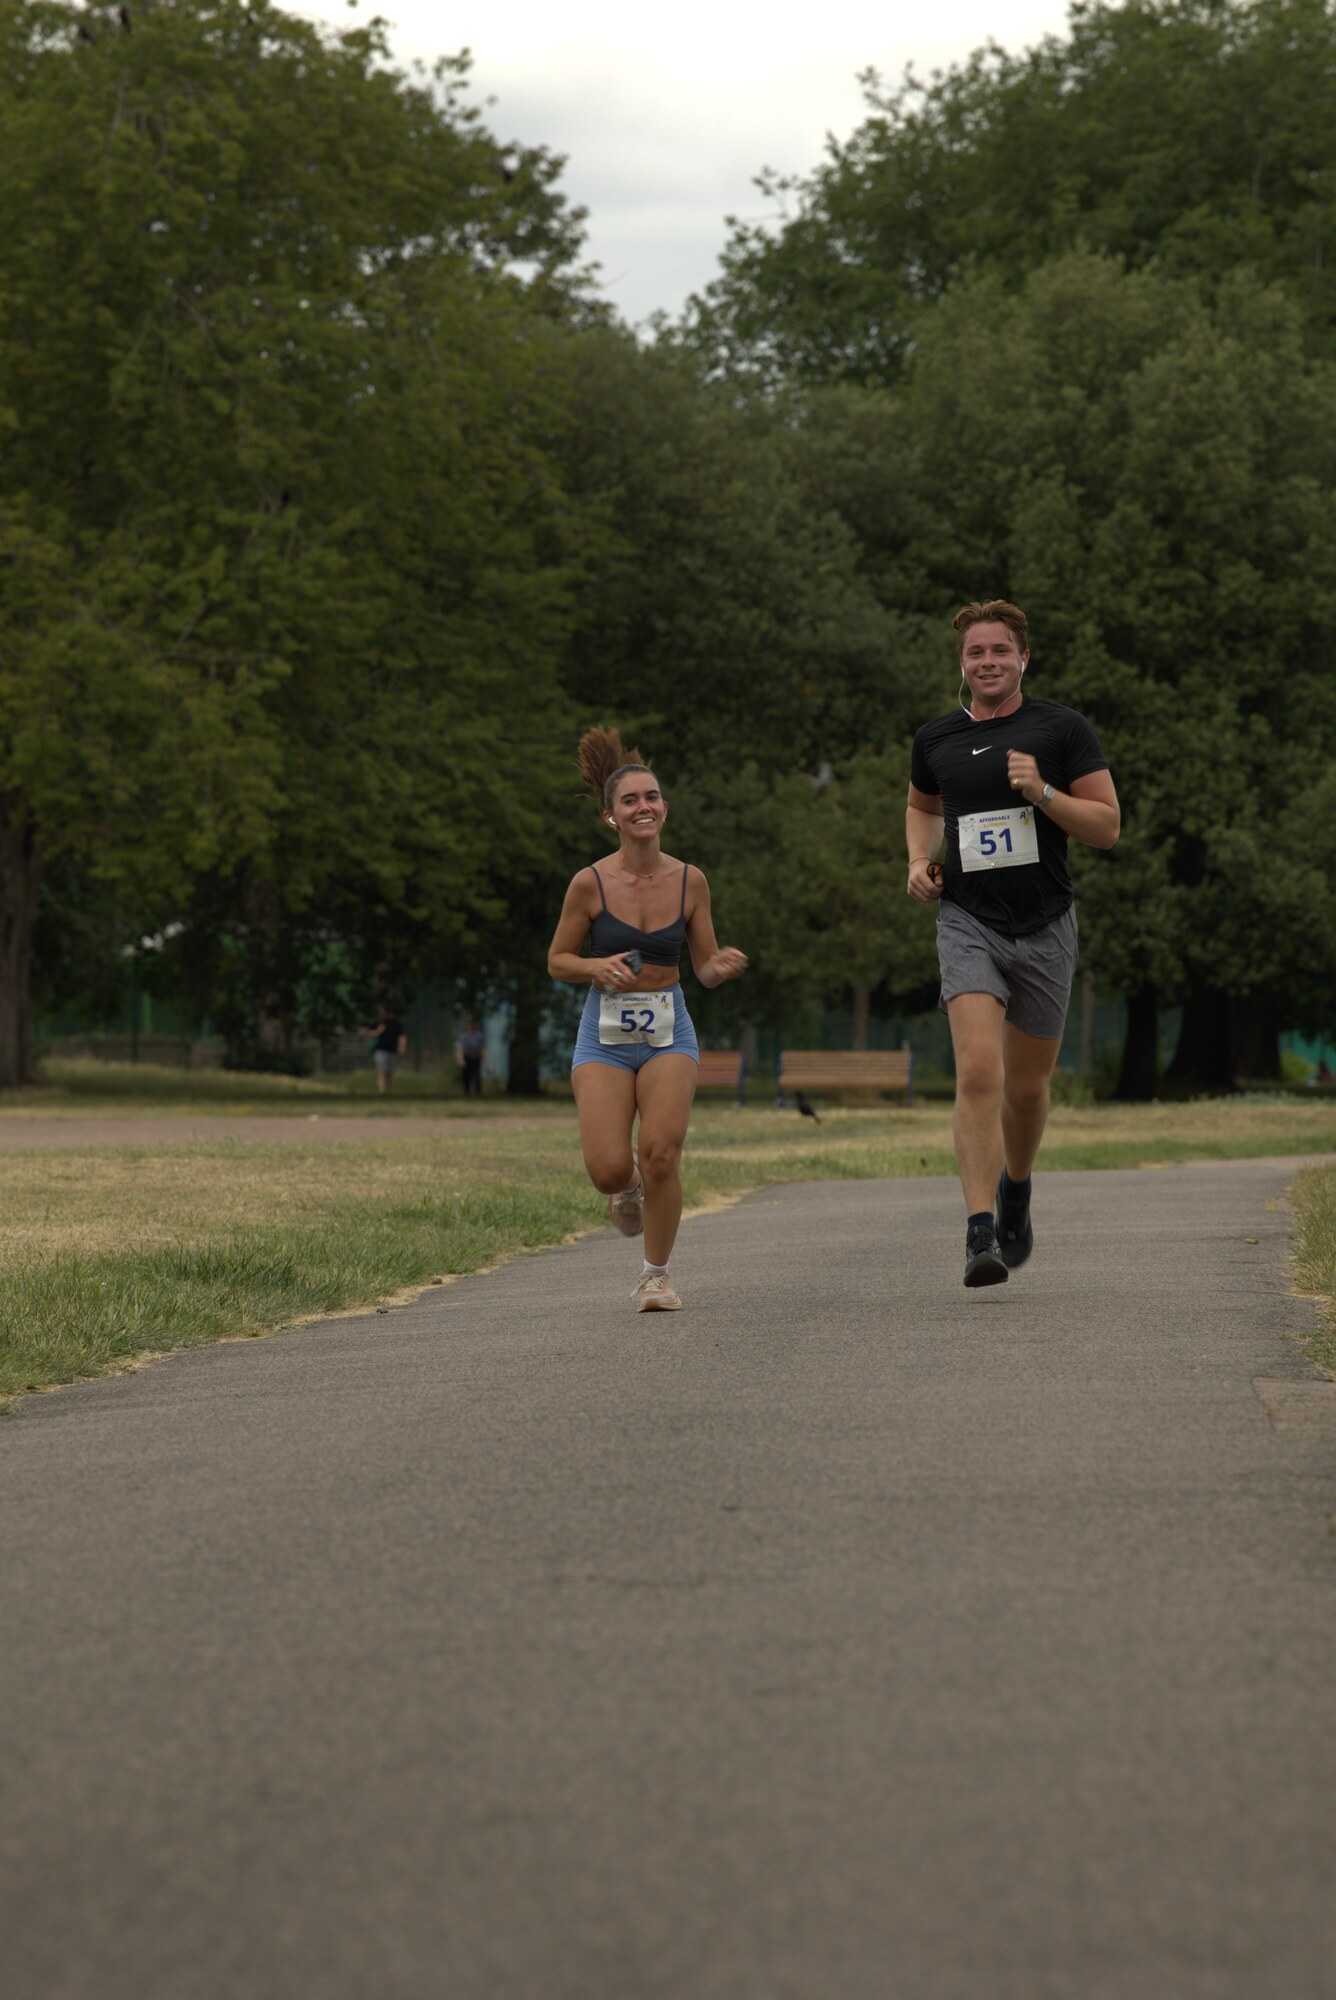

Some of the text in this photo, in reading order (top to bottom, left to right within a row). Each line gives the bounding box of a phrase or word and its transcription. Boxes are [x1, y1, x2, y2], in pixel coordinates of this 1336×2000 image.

[979, 815, 1010, 823] AFFORDABLE
[980, 828, 1013, 856] 51
[620, 1009, 655, 1034] 52
